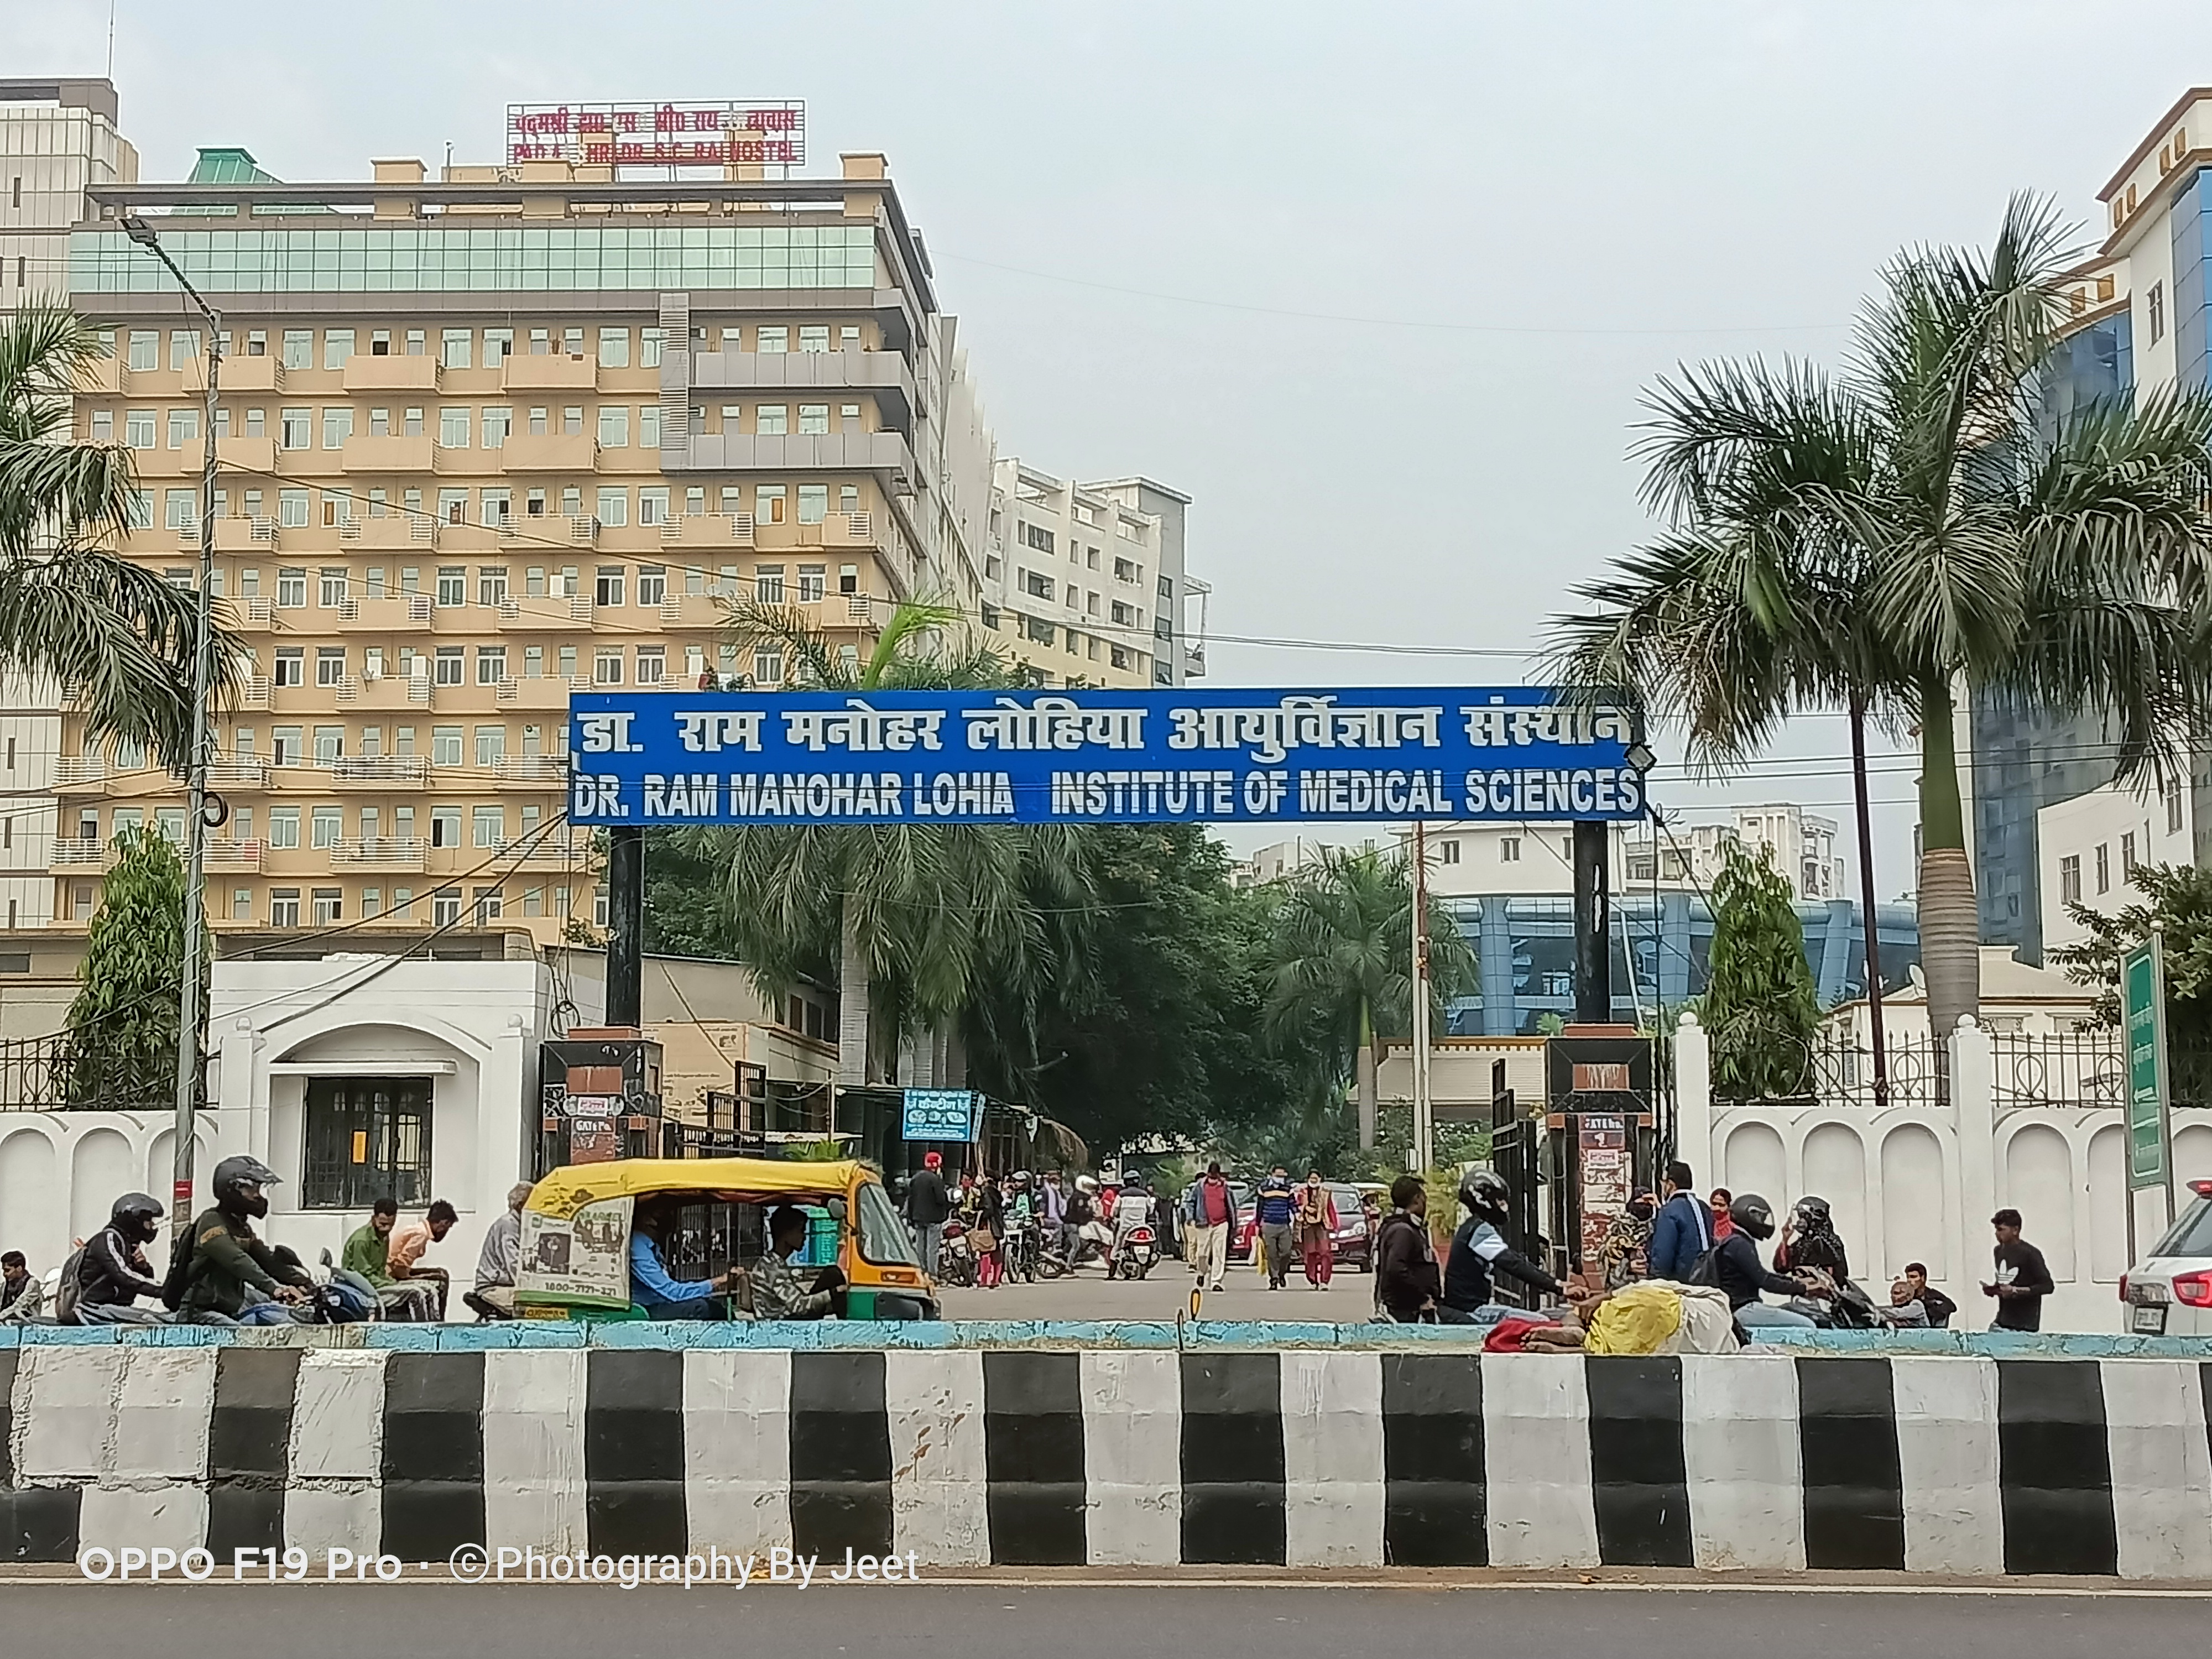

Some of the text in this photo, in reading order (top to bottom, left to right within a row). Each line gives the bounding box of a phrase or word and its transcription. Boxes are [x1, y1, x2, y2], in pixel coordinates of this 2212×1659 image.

[577, 695, 1631, 763] डा. राम मनोहर लोहिया आयुर्विज्ञान संस्थान
[575, 769, 1640, 817] DR. RAM MANOHAR LOHIA INSTITUTE OF MEDICAL SCIENCES
